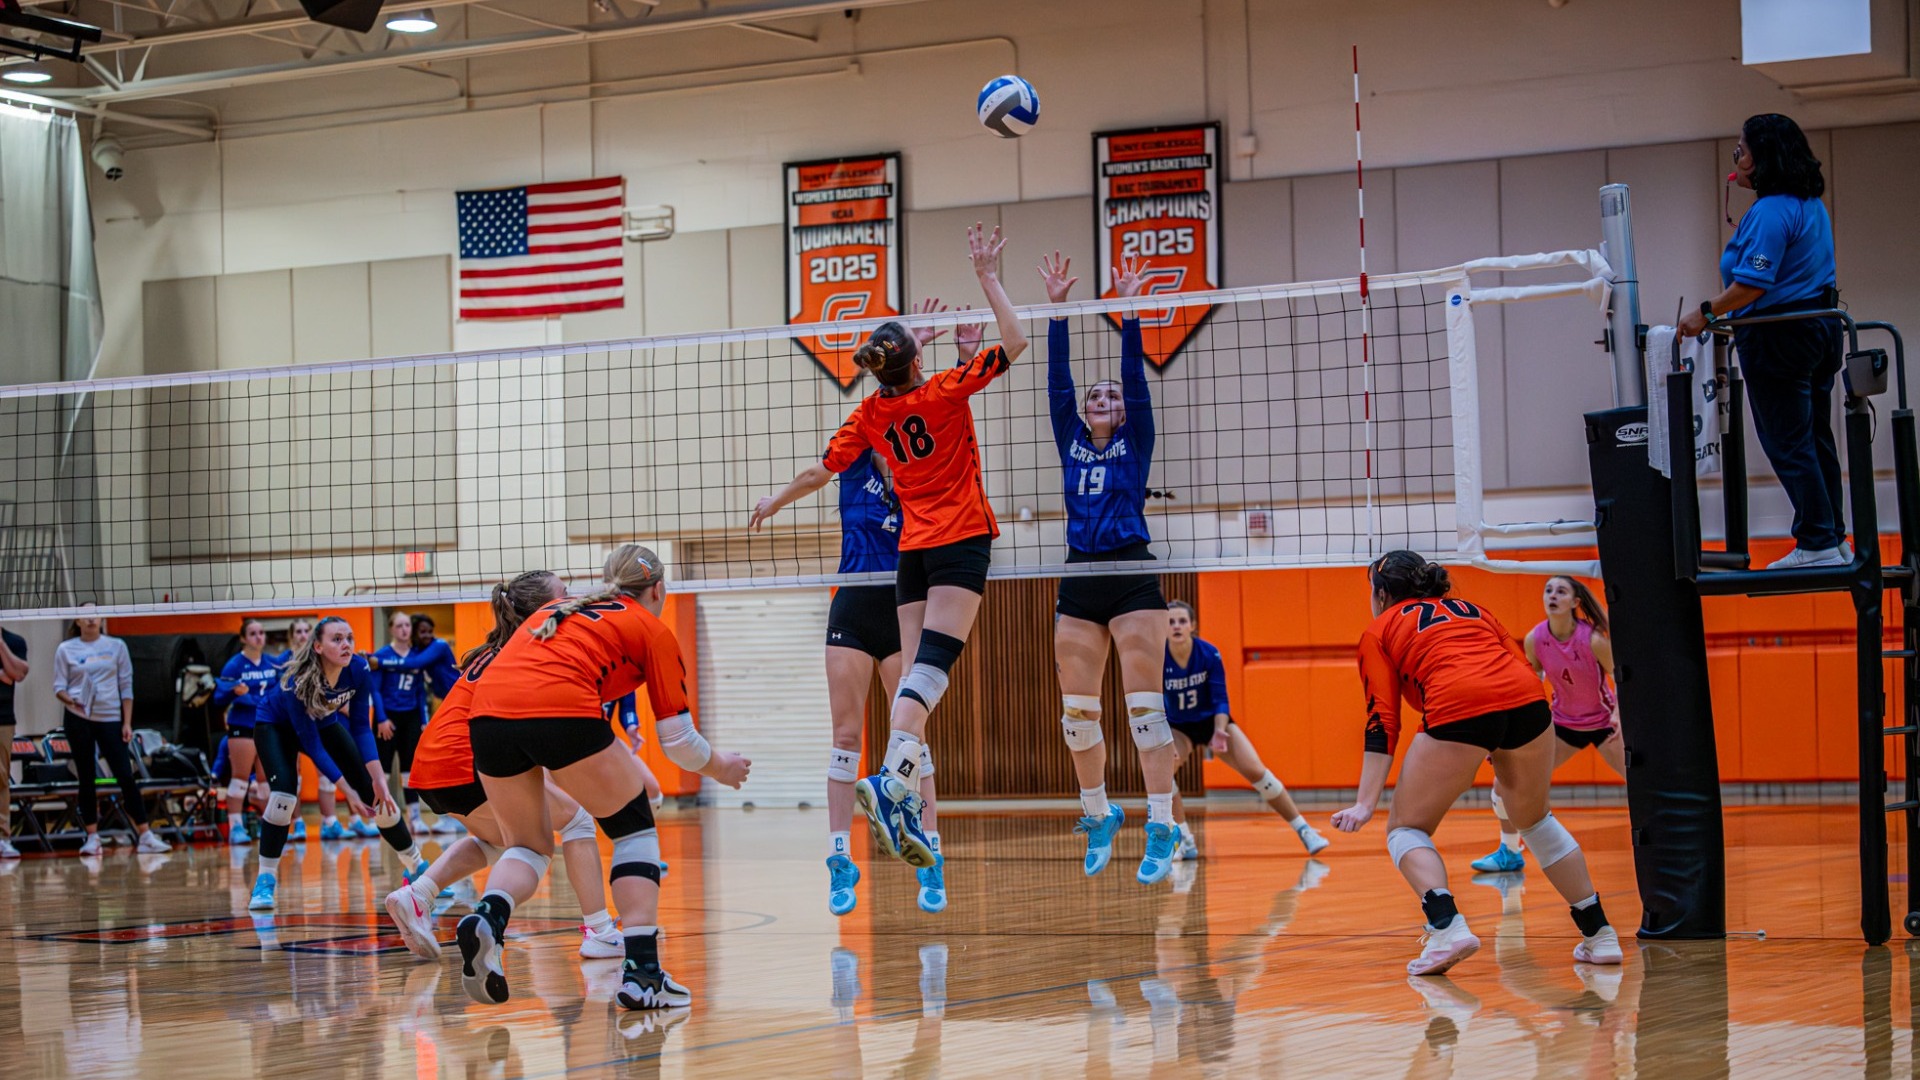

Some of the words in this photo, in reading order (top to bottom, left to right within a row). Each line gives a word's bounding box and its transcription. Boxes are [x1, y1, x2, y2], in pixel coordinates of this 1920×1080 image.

[1104, 160, 1149, 176] WOMEN'S
[1150, 154, 1209, 172] BASKETBALL
[795, 190, 835, 204] WOMEN'S
[836, 183, 891, 200] BASKETBALL
[1138, 177, 1199, 191] TOURNAMENT
[1105, 194, 1210, 228] CHAMPIONS
[795, 220, 892, 254] TOURNAMENT
[1122, 227, 1195, 257] 2025
[810, 254, 877, 284] 2025
[883, 414, 935, 464] 18
[1078, 466, 1106, 495] 19
[1401, 598, 1481, 634] 20
[260, 681, 267, 696] 7
[399, 673, 413, 691] 12
[1562, 668, 1574, 685] 4
[1178, 689, 1198, 710] 13
